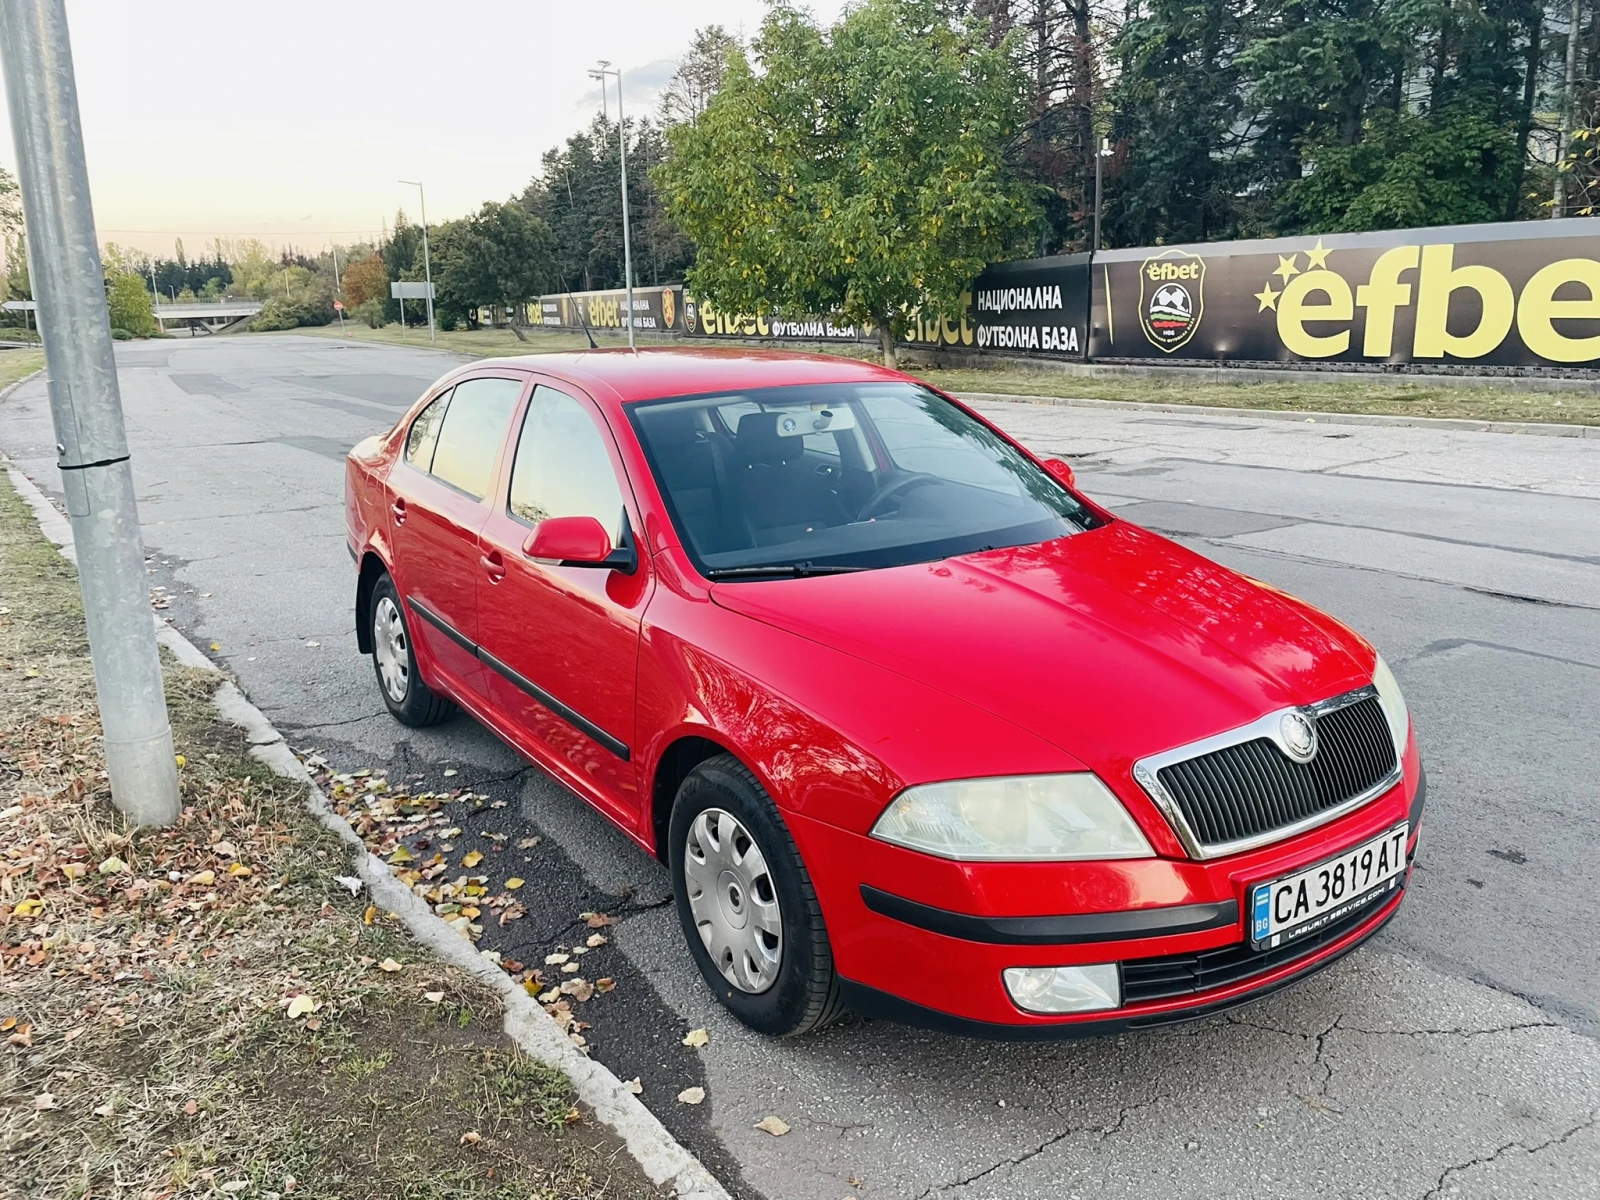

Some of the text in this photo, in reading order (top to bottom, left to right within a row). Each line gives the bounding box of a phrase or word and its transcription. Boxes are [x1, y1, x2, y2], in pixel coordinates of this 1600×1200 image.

[1149, 261, 1199, 281] efbet
[589, 295, 620, 327] efbet
[977, 285, 1063, 314] НАЦИОНАЛНА
[772, 321, 825, 337] ФУТБОЛНА
[977, 324, 1079, 351] ФУТБОЛНА БАЗА
[1256, 917, 1268, 932] BG
